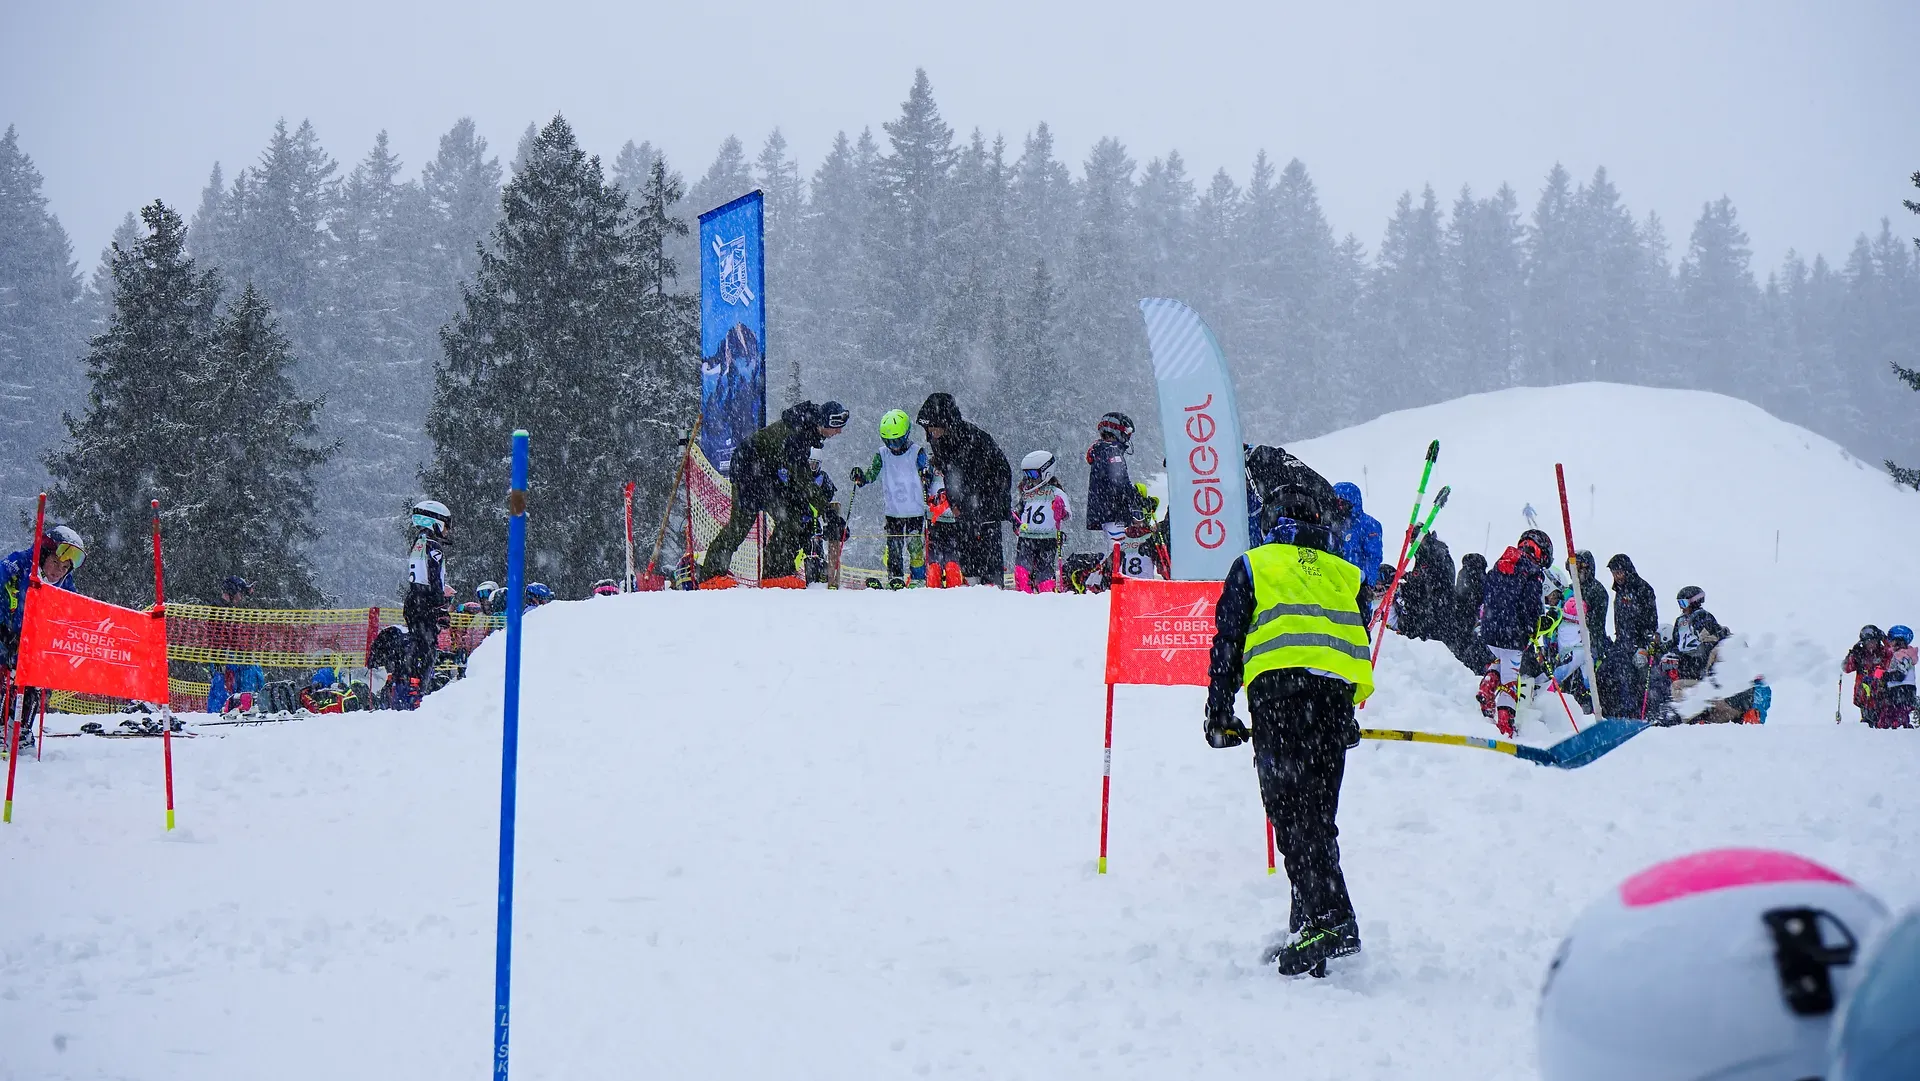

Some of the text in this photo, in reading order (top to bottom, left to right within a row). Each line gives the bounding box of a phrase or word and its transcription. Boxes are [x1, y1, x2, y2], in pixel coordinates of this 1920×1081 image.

[1026, 505, 1046, 525] 16
[1122, 557, 1142, 575] 18
[1153, 620, 1216, 632] SC OBER-
[81, 632, 121, 647] OBER-
[1142, 633, 1214, 646] MAISELSTE
[1295, 933, 1325, 951] HEAD
